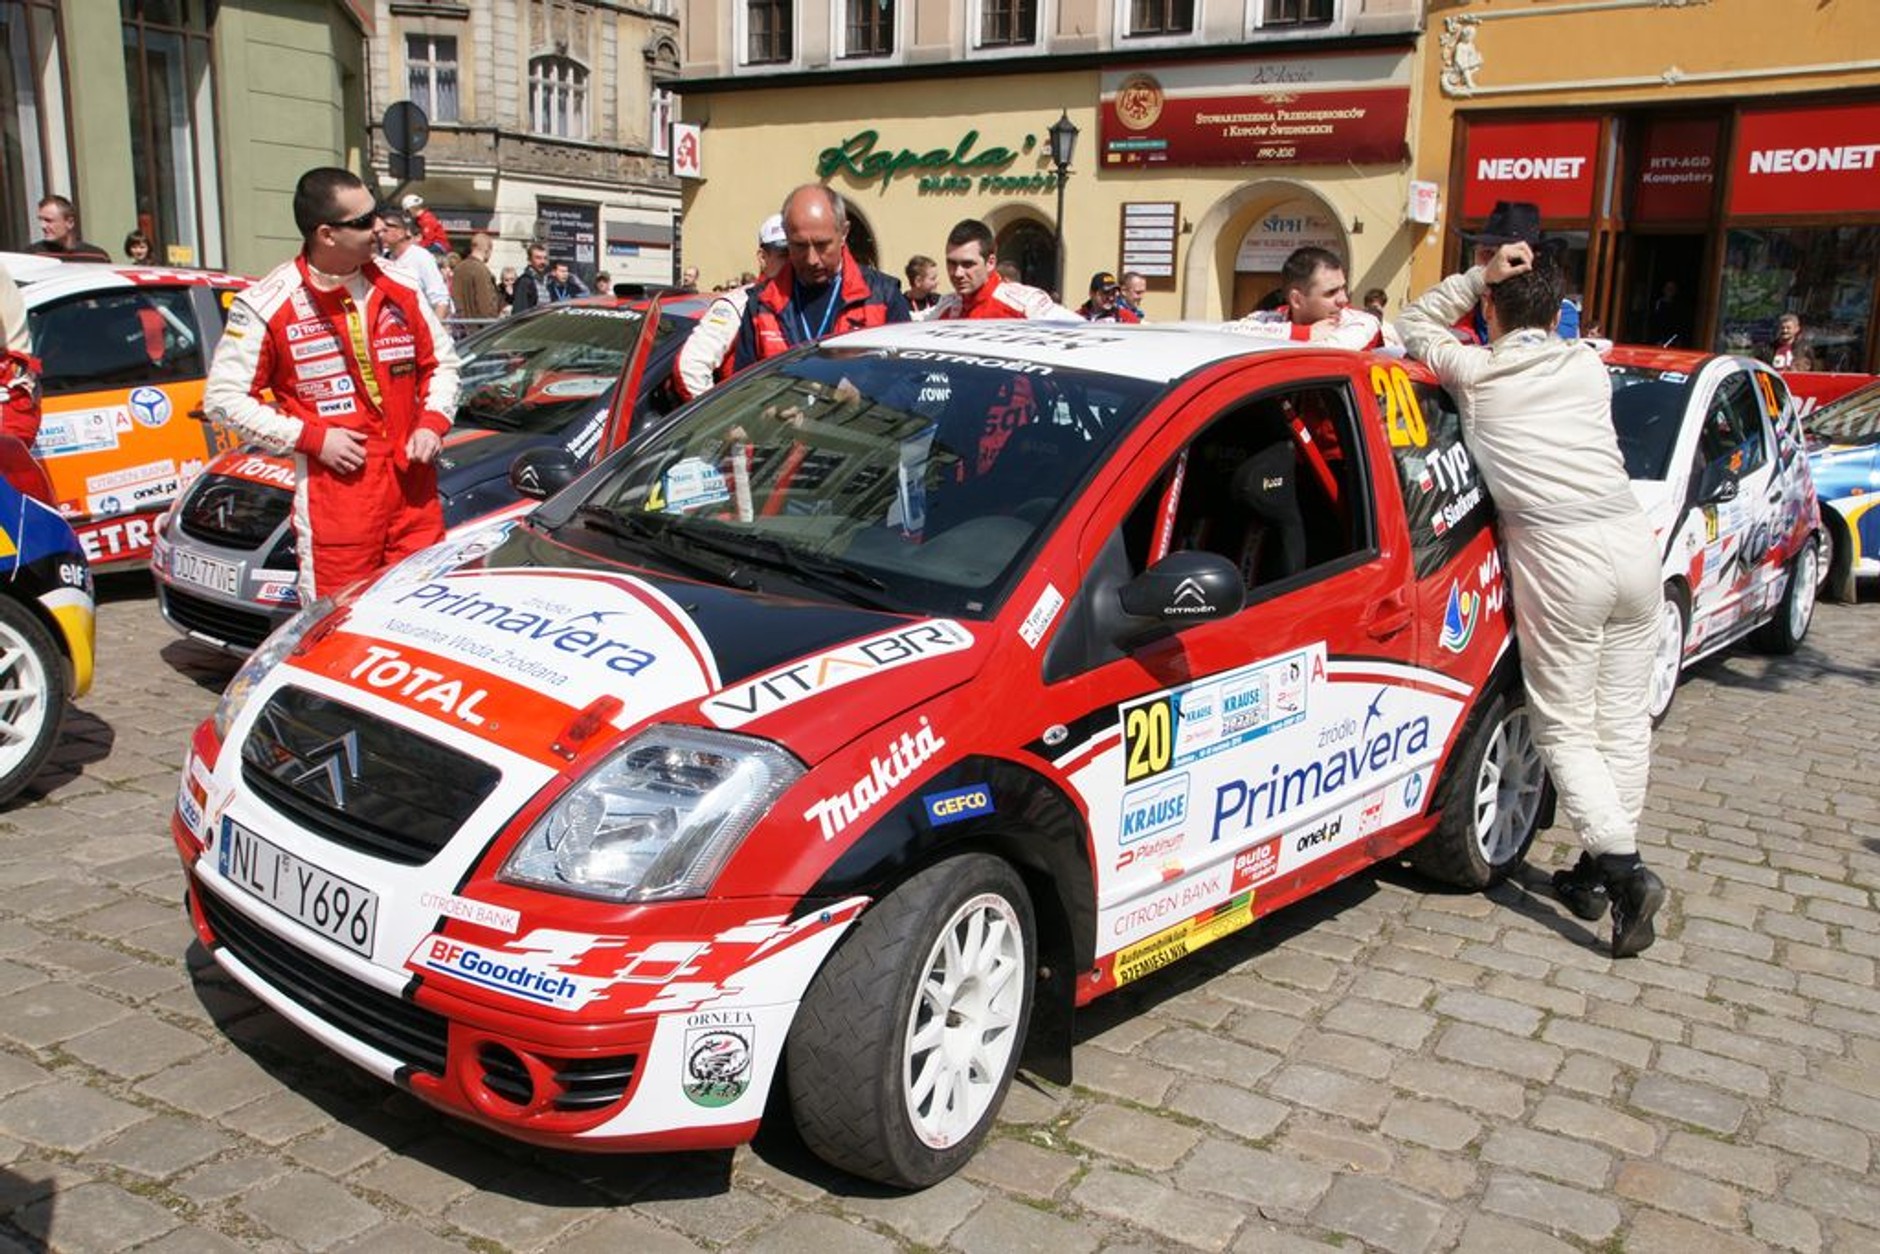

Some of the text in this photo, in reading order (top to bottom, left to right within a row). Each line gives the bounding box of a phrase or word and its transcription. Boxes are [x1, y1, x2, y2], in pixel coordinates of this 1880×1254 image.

[1477, 156, 1587, 181] NEONET
[1749, 143, 1880, 175] NEONET
[899, 350, 1055, 376] CITROËN
[114, 411, 129, 427] A
[1371, 364, 1429, 449] 20
[236, 457, 297, 486] TOTAL
[60, 563, 85, 587] elf
[395, 583, 658, 678] Primavera
[1311, 653, 1326, 683] A
[349, 645, 487, 727] TOTAL
[1223, 687, 1261, 714] KRAUSE
[1126, 701, 1171, 780] 20
[1210, 715, 1430, 844] Primavera
[932, 791, 989, 817] GEFCO
[1123, 792, 1186, 838] KRAUSE
[297, 865, 369, 946] Y696
[1181, 879, 1221, 909] BANK
[475, 907, 515, 928] BANK
[429, 940, 577, 998] BFGoodrich
[687, 1011, 754, 1027] ORNETA
